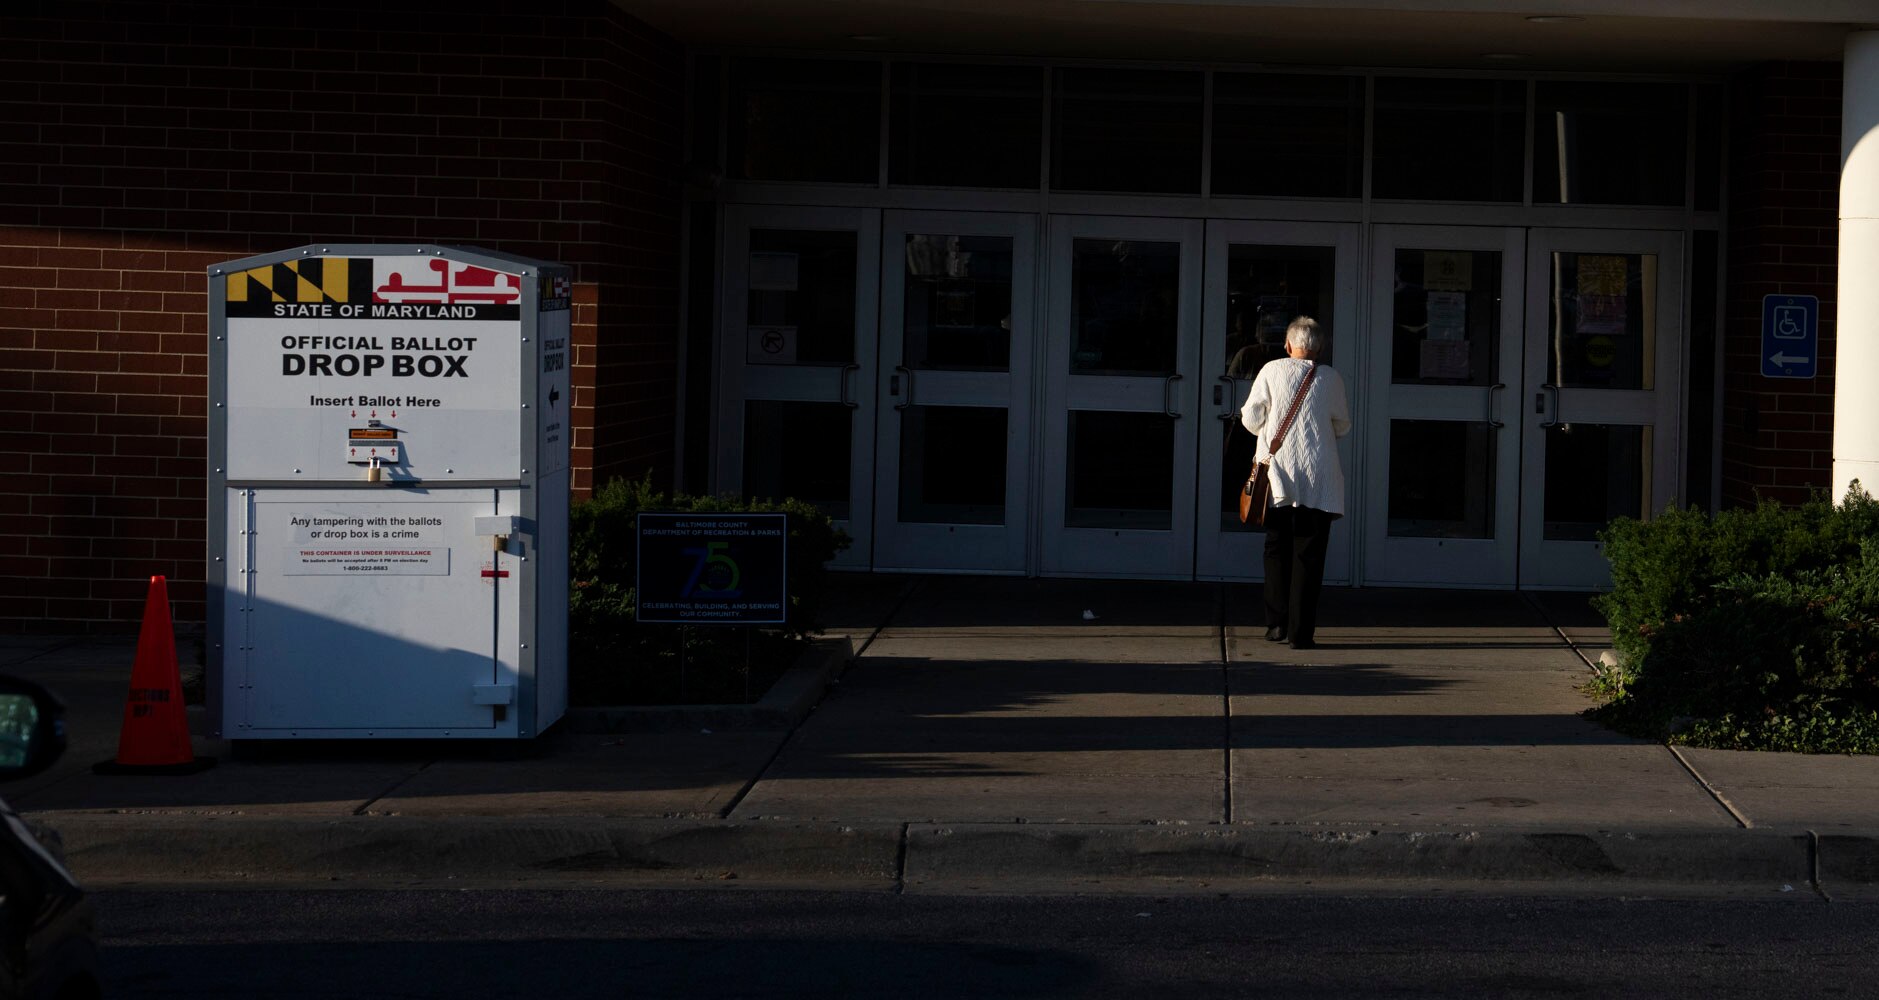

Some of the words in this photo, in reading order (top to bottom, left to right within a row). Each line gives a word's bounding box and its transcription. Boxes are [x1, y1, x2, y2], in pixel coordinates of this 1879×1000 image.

[273, 304, 332, 317] STATE
[339, 304, 365, 318] OF
[371, 305, 477, 319] MARYLAND
[281, 335, 384, 350] OFFICIAL
[391, 337, 478, 351] BALLOT
[282, 354, 385, 376] DROP
[392, 355, 469, 377] BOX
[310, 395, 354, 407] Insert
[359, 395, 402, 407] Ballot
[406, 396, 441, 407] Here
[291, 517, 311, 528] Any
[313, 517, 364, 528] tampering
[366, 517, 388, 526] with
[390, 517, 406, 526] the
[408, 517, 442, 526] ballots
[324, 529, 347, 540] drop
[350, 530, 368, 539] box
[371, 530, 380, 539] is
[382, 531, 389, 539] a
[391, 530, 420, 539] crime
